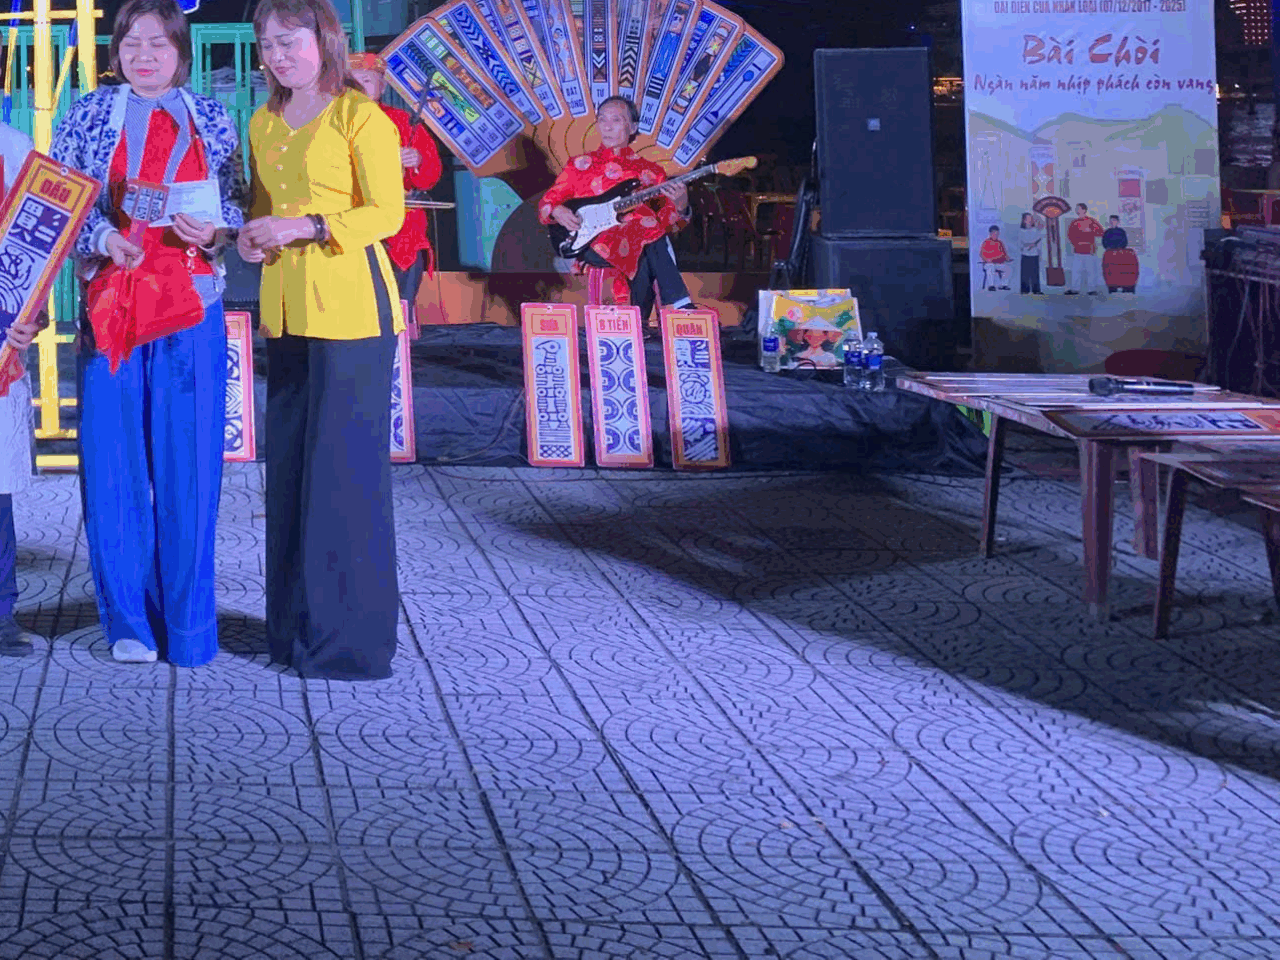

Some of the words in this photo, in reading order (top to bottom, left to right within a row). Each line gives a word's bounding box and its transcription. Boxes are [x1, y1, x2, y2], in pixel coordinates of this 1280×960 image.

[1023, 34, 1074, 65] Bài
[1088, 33, 1160, 67] Chòi
[974, 74, 1013, 95] Ngàn
[1020, 74, 1051, 91] năm
[1057, 74, 1091, 95] nhịp
[1097, 74, 1140, 95] phách
[1146, 73, 1171, 91] còn
[1177, 78, 1214, 95] vang
